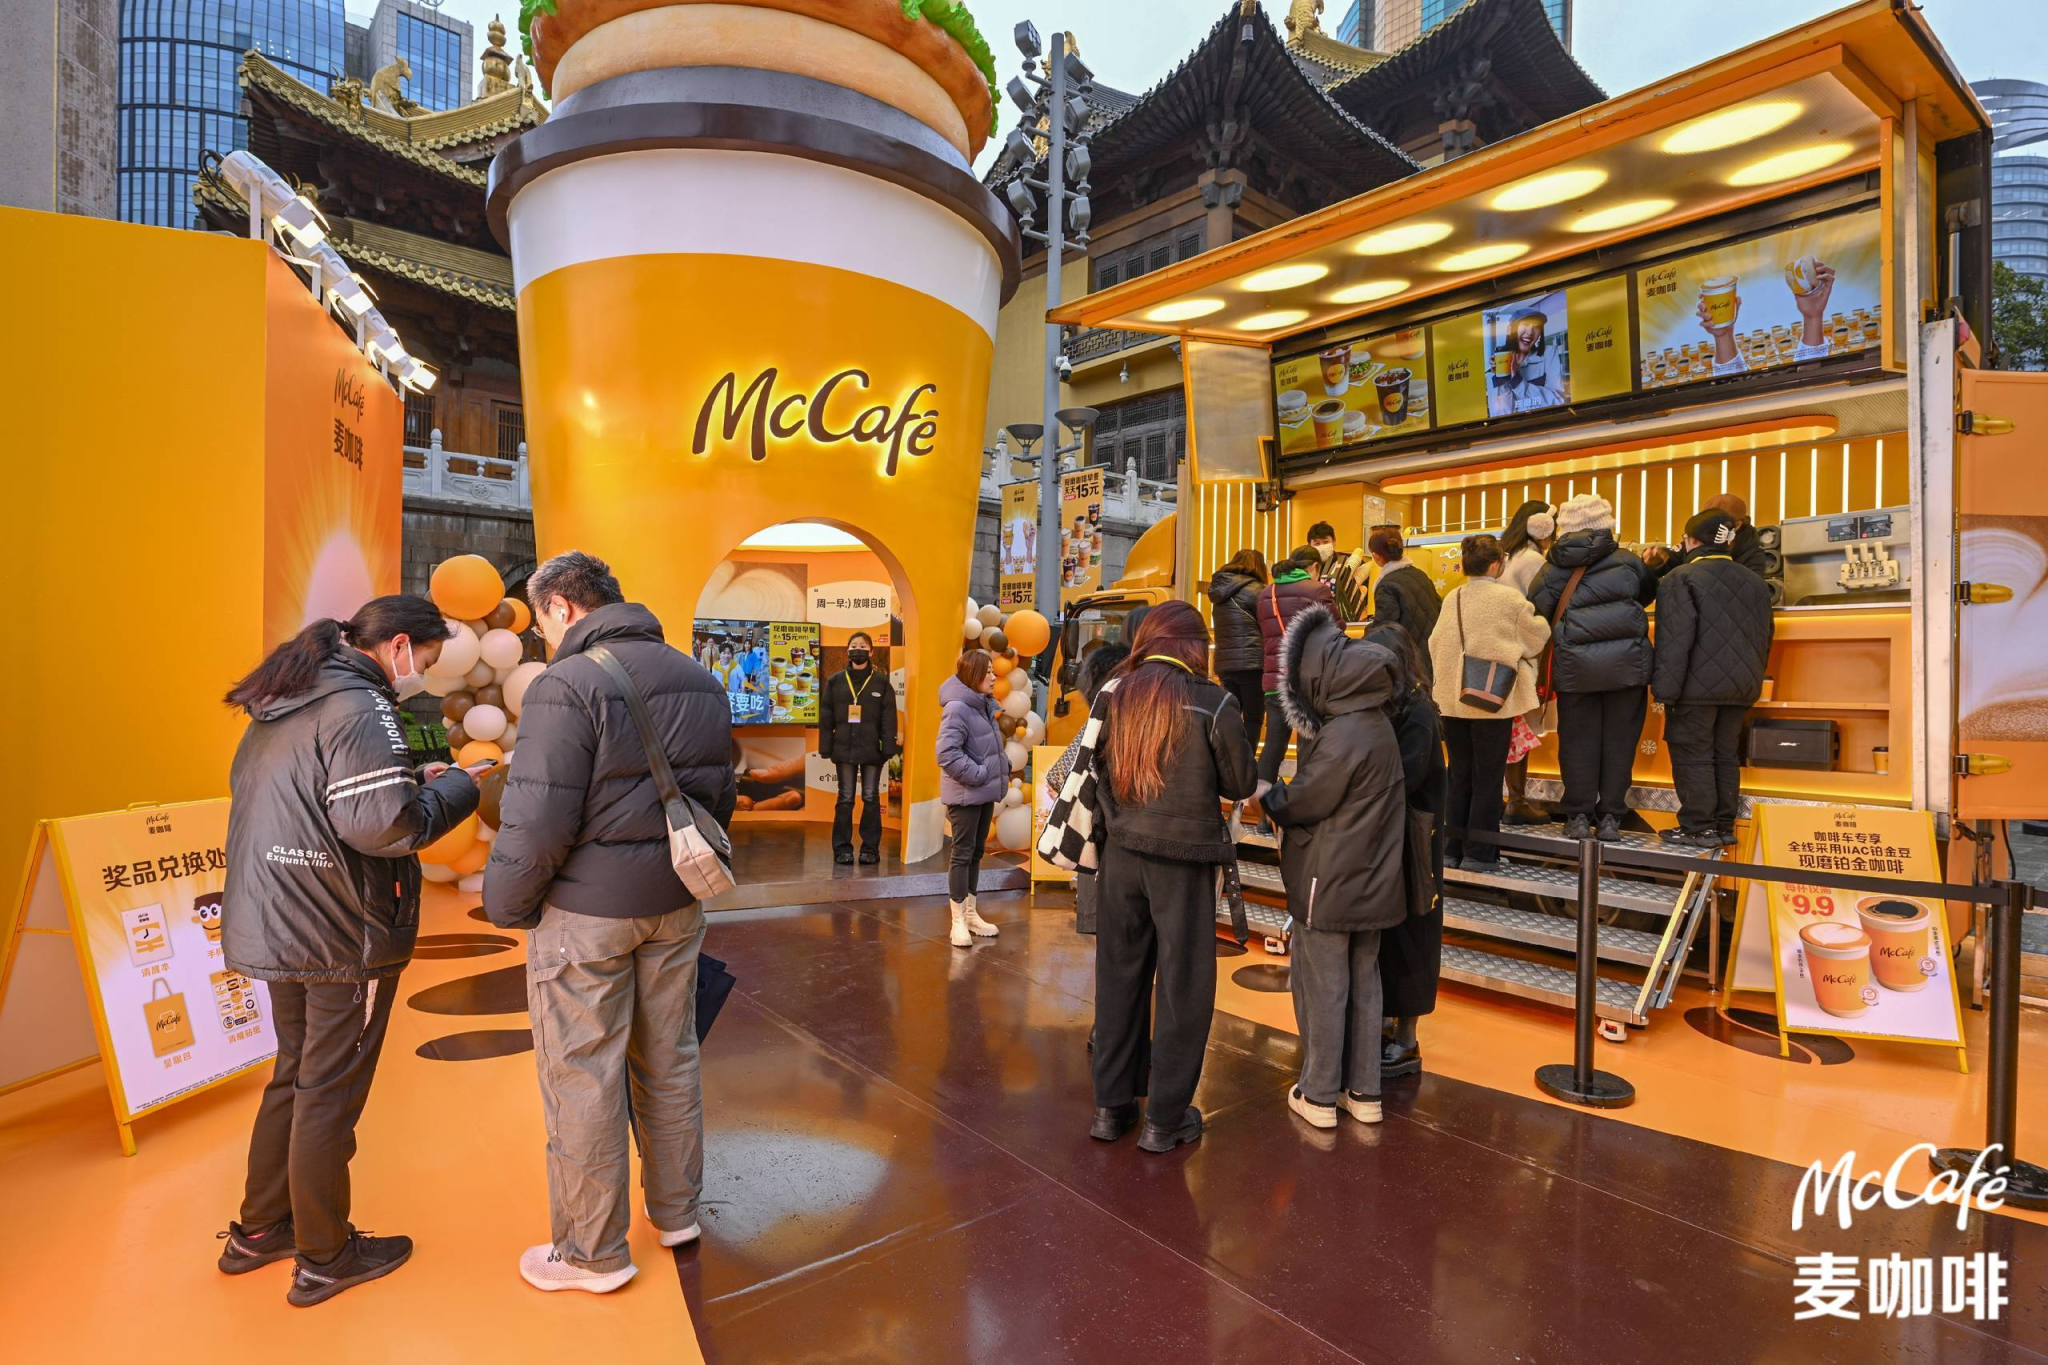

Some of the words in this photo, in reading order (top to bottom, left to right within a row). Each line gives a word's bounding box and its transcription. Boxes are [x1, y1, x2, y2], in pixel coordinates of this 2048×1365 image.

[1645, 268, 1677, 286] McCafé
[1646, 282, 1677, 298] 麦咖啡
[1585, 326, 1613, 342] McCafé
[1586, 343, 1613, 352] 麦咖啡
[1447, 358, 1469, 373] McCafé
[334, 368, 365, 423] McCafé
[692, 368, 939, 477] McCafé
[334, 418, 363, 471] 麦咖啡
[148, 824, 171, 834] 麦咖啡
[1814, 831, 1882, 845] 咖啡车专享
[272, 845, 328, 860] CLASSIC
[102, 847, 227, 892] 奖品兑换处
[1799, 854, 1904, 874] 现磨铂金咖啡
[1880, 947, 1916, 960] McCafé
[1823, 974, 1857, 986] McCafé
